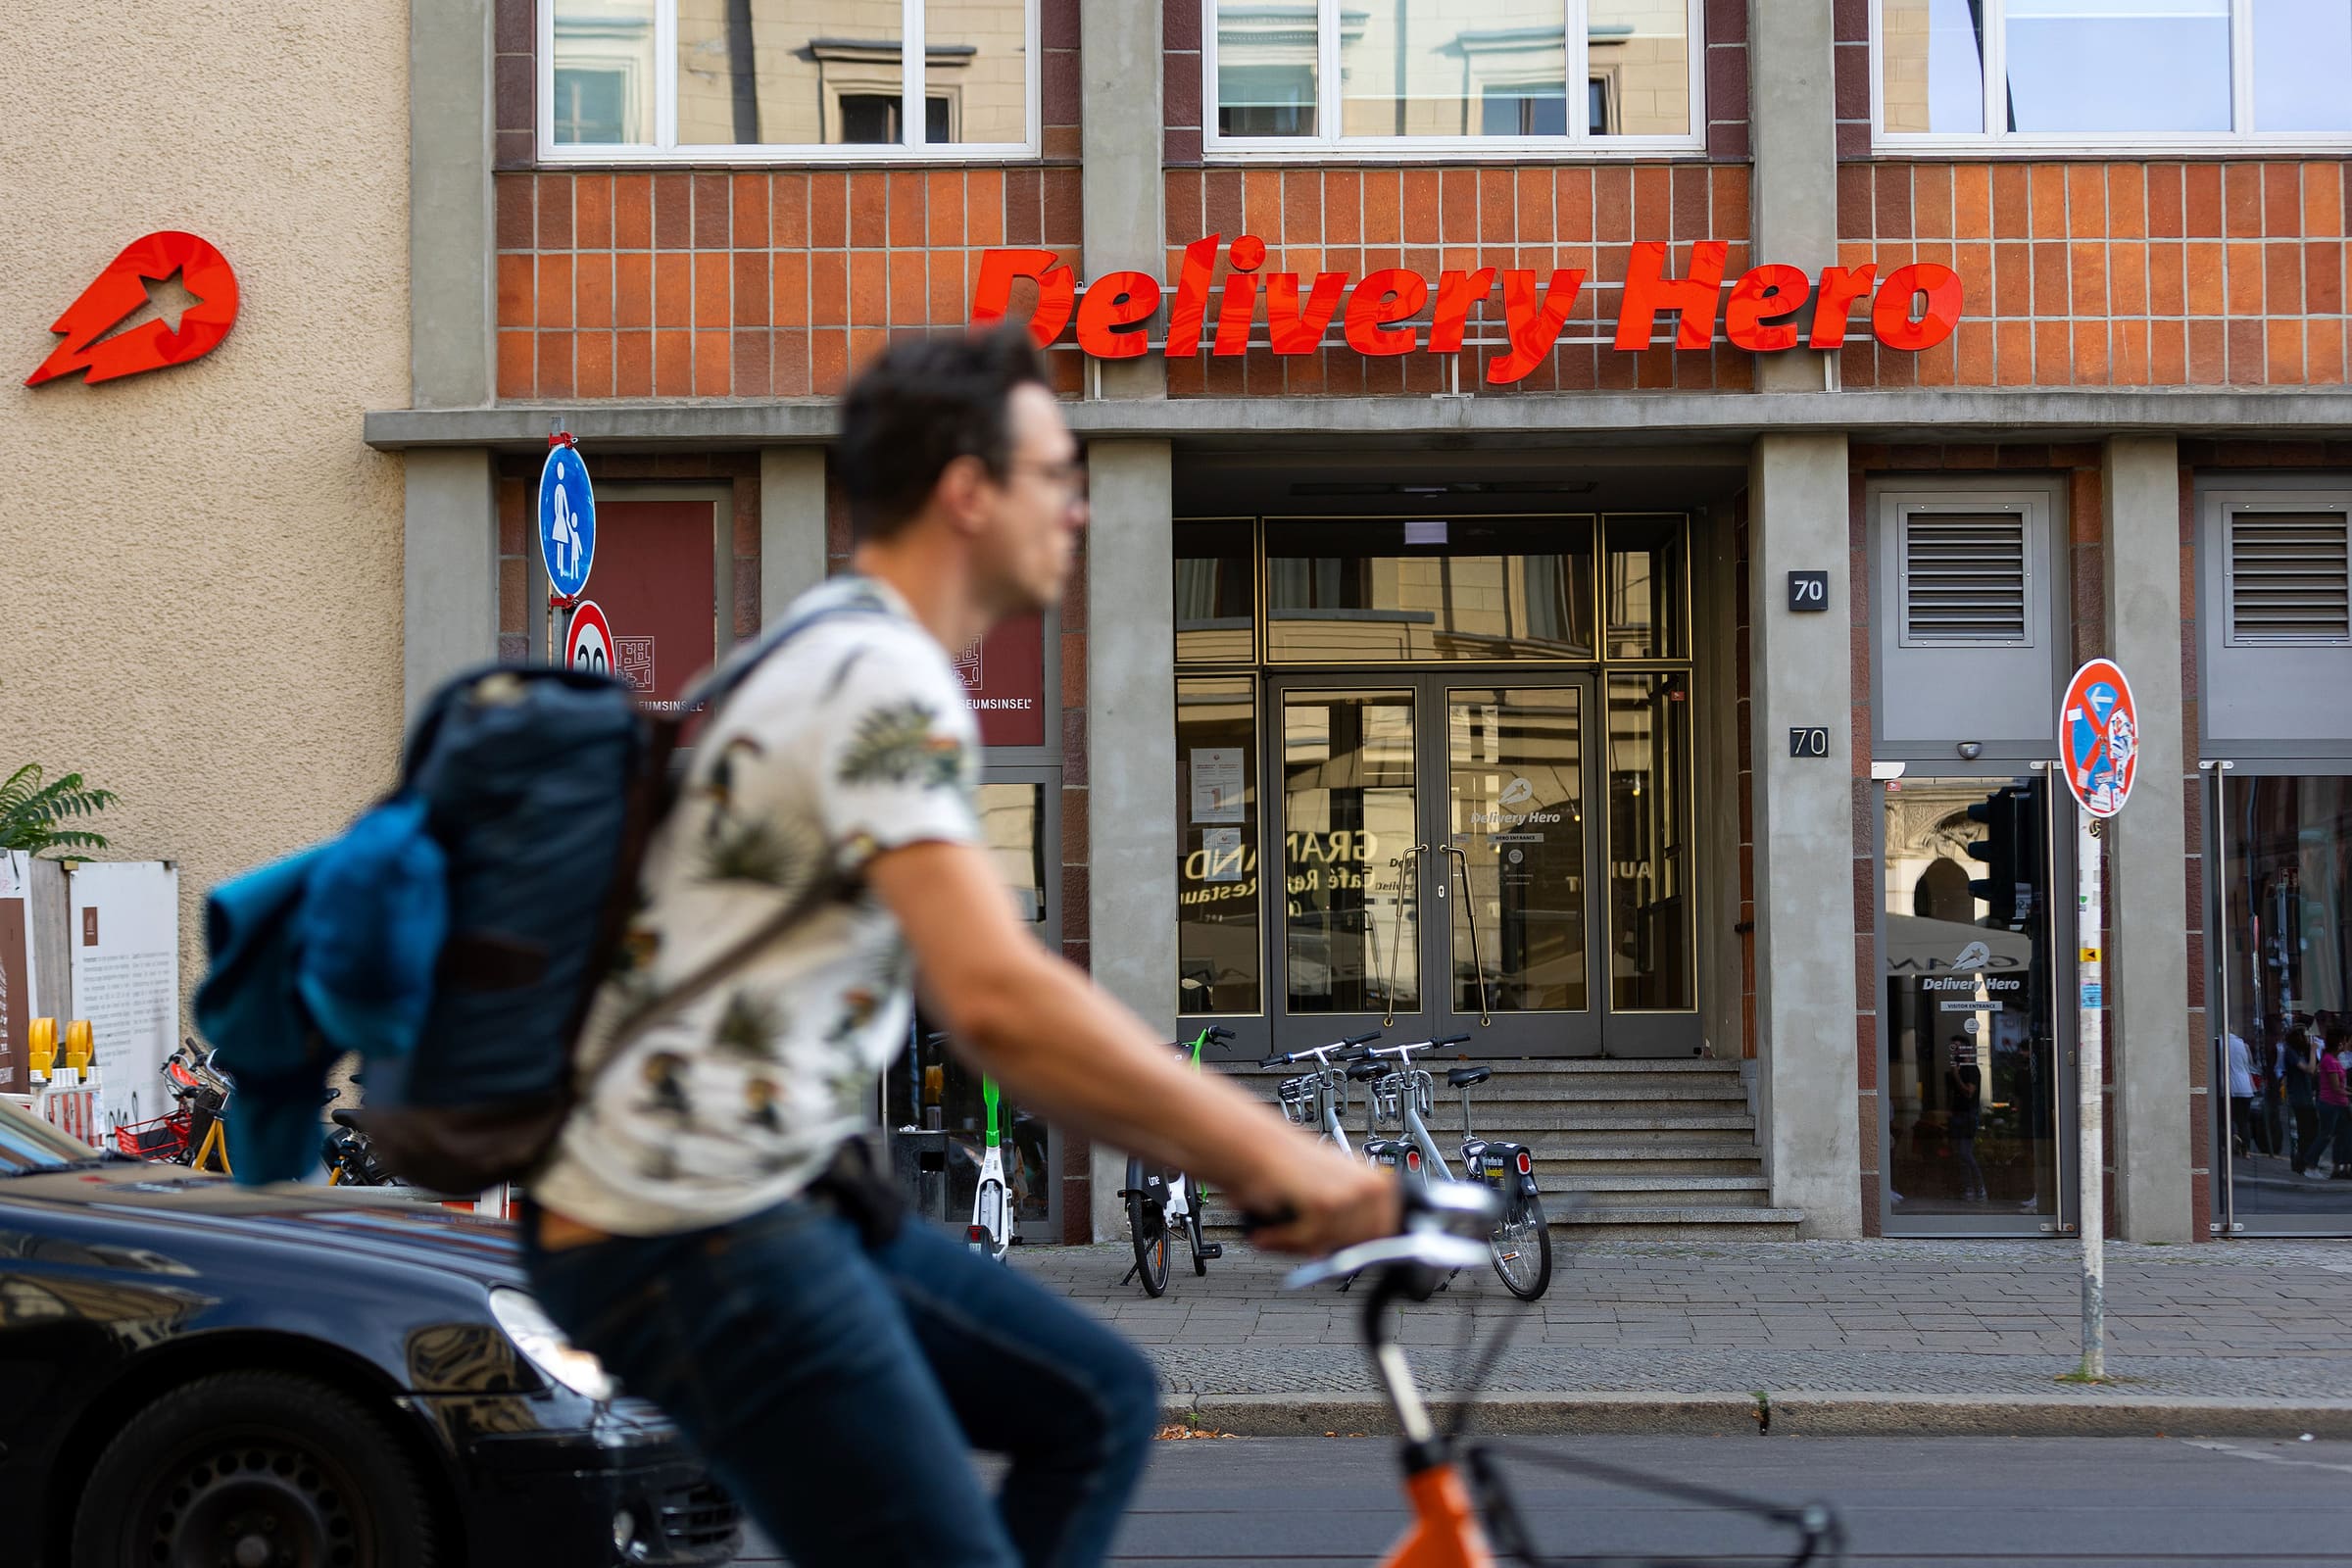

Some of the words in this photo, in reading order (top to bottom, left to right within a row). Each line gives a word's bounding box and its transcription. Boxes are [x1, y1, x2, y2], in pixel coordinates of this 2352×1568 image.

[970, 233, 1586, 383] Delivery
[1614, 240, 1964, 351] Hero
[1794, 580, 1823, 601] 70
[1792, 729, 1827, 755] 70
[1470, 811, 1527, 825] Delivery
[1529, 812, 1561, 823] Hero
[1923, 977, 1983, 993] Delivery
[1986, 978, 2020, 990] Hero
